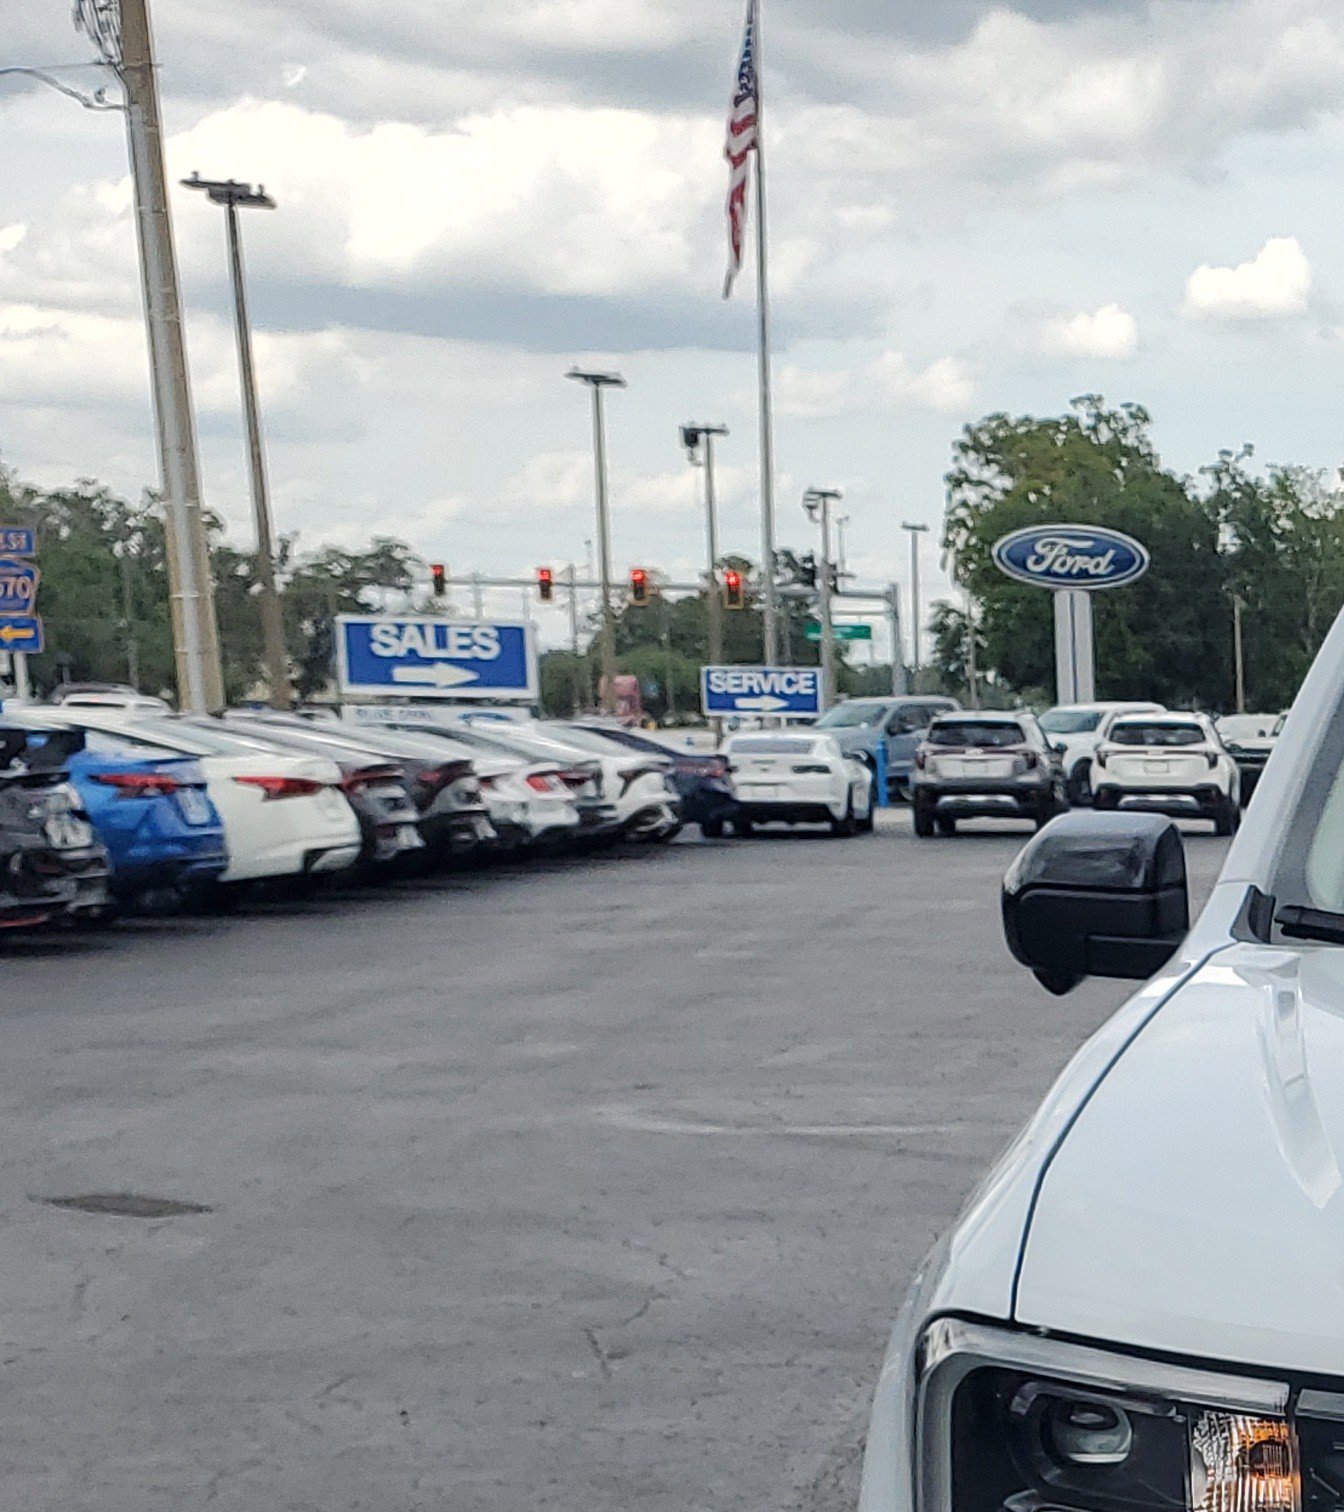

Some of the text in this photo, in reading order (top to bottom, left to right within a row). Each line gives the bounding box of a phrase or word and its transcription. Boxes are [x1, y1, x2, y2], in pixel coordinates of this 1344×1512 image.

[1026, 537, 1117, 575] Ford
[370, 624, 501, 661] SALES
[709, 672, 816, 694] SERVICE
